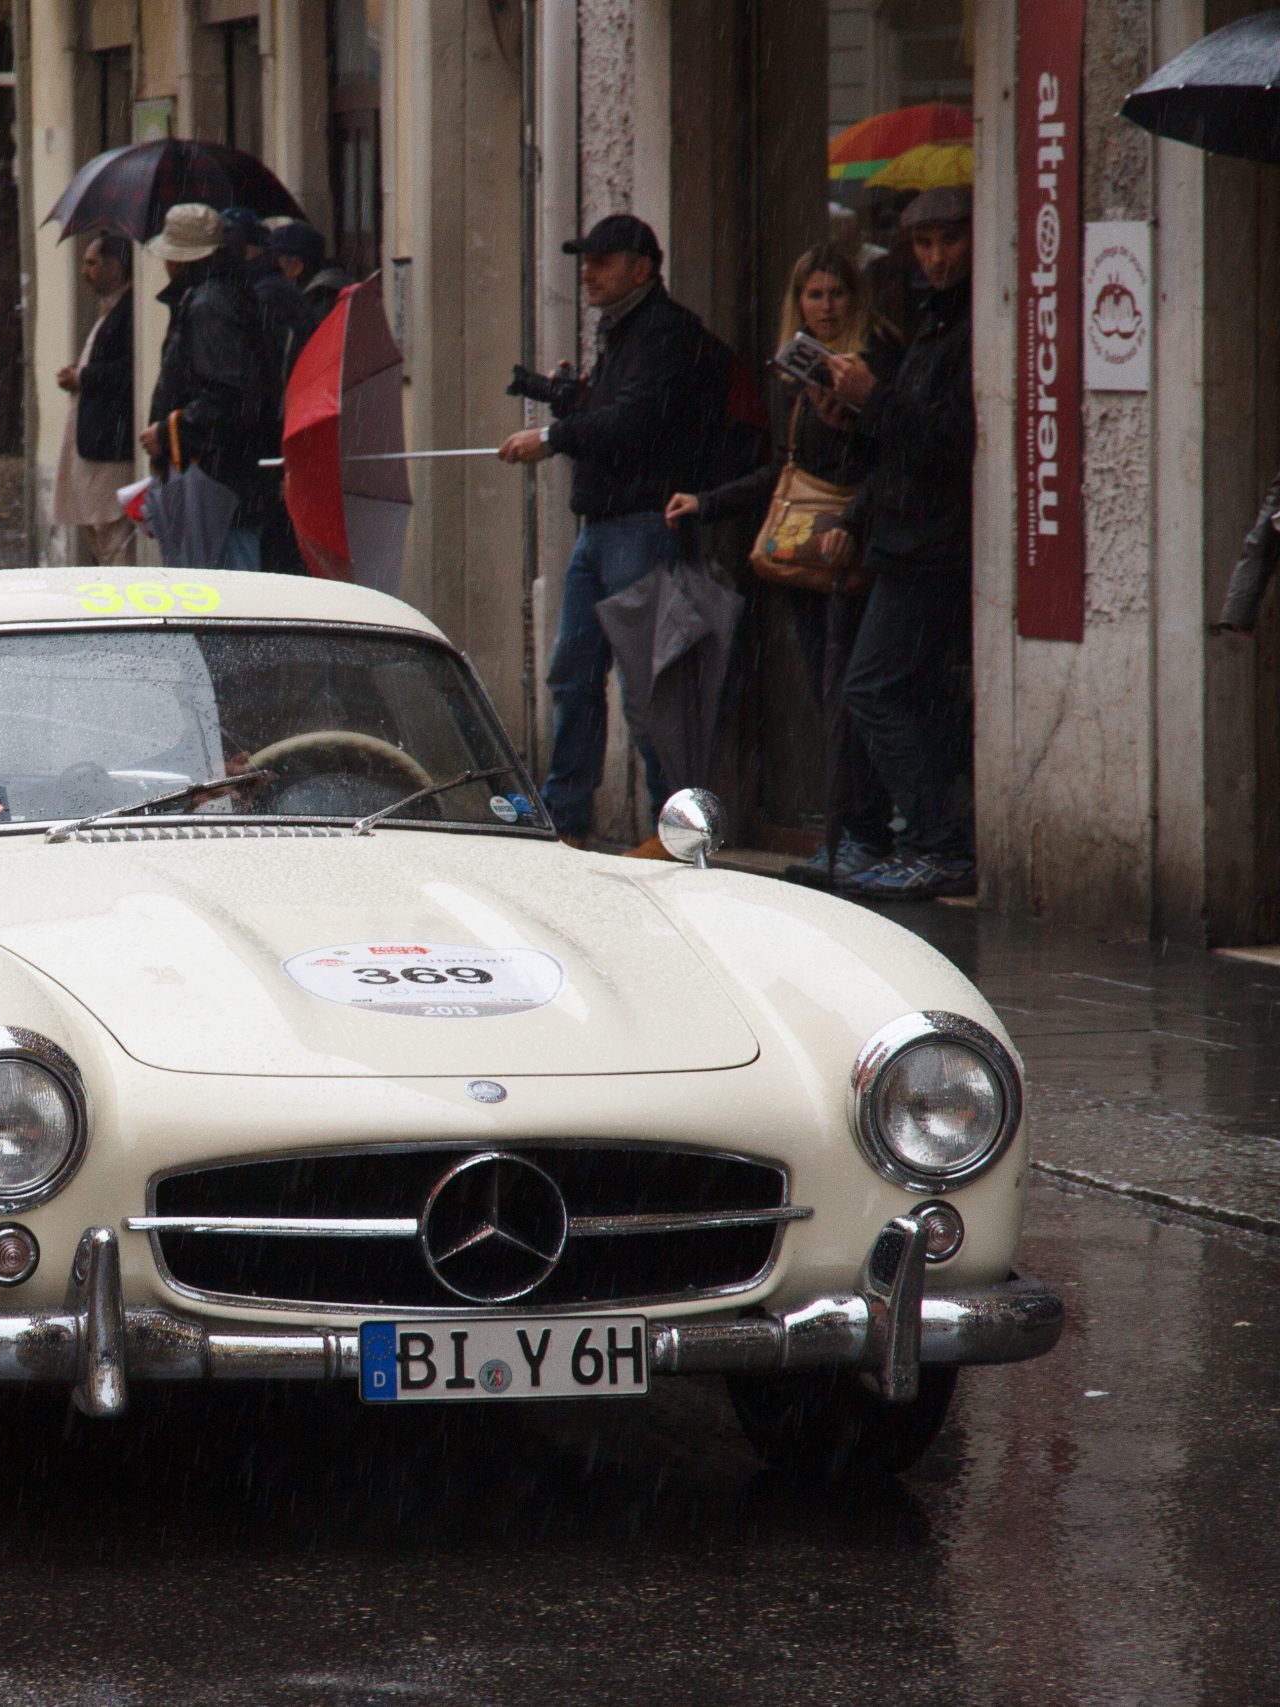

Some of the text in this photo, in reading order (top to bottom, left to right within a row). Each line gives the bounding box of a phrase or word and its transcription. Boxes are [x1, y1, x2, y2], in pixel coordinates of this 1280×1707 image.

[76, 582, 222, 613] 369
[352, 966, 494, 985] 369
[421, 1005, 479, 1017] 2013
[399, 1326, 644, 1389] BI Y 6H
[373, 1371, 386, 1388] D
